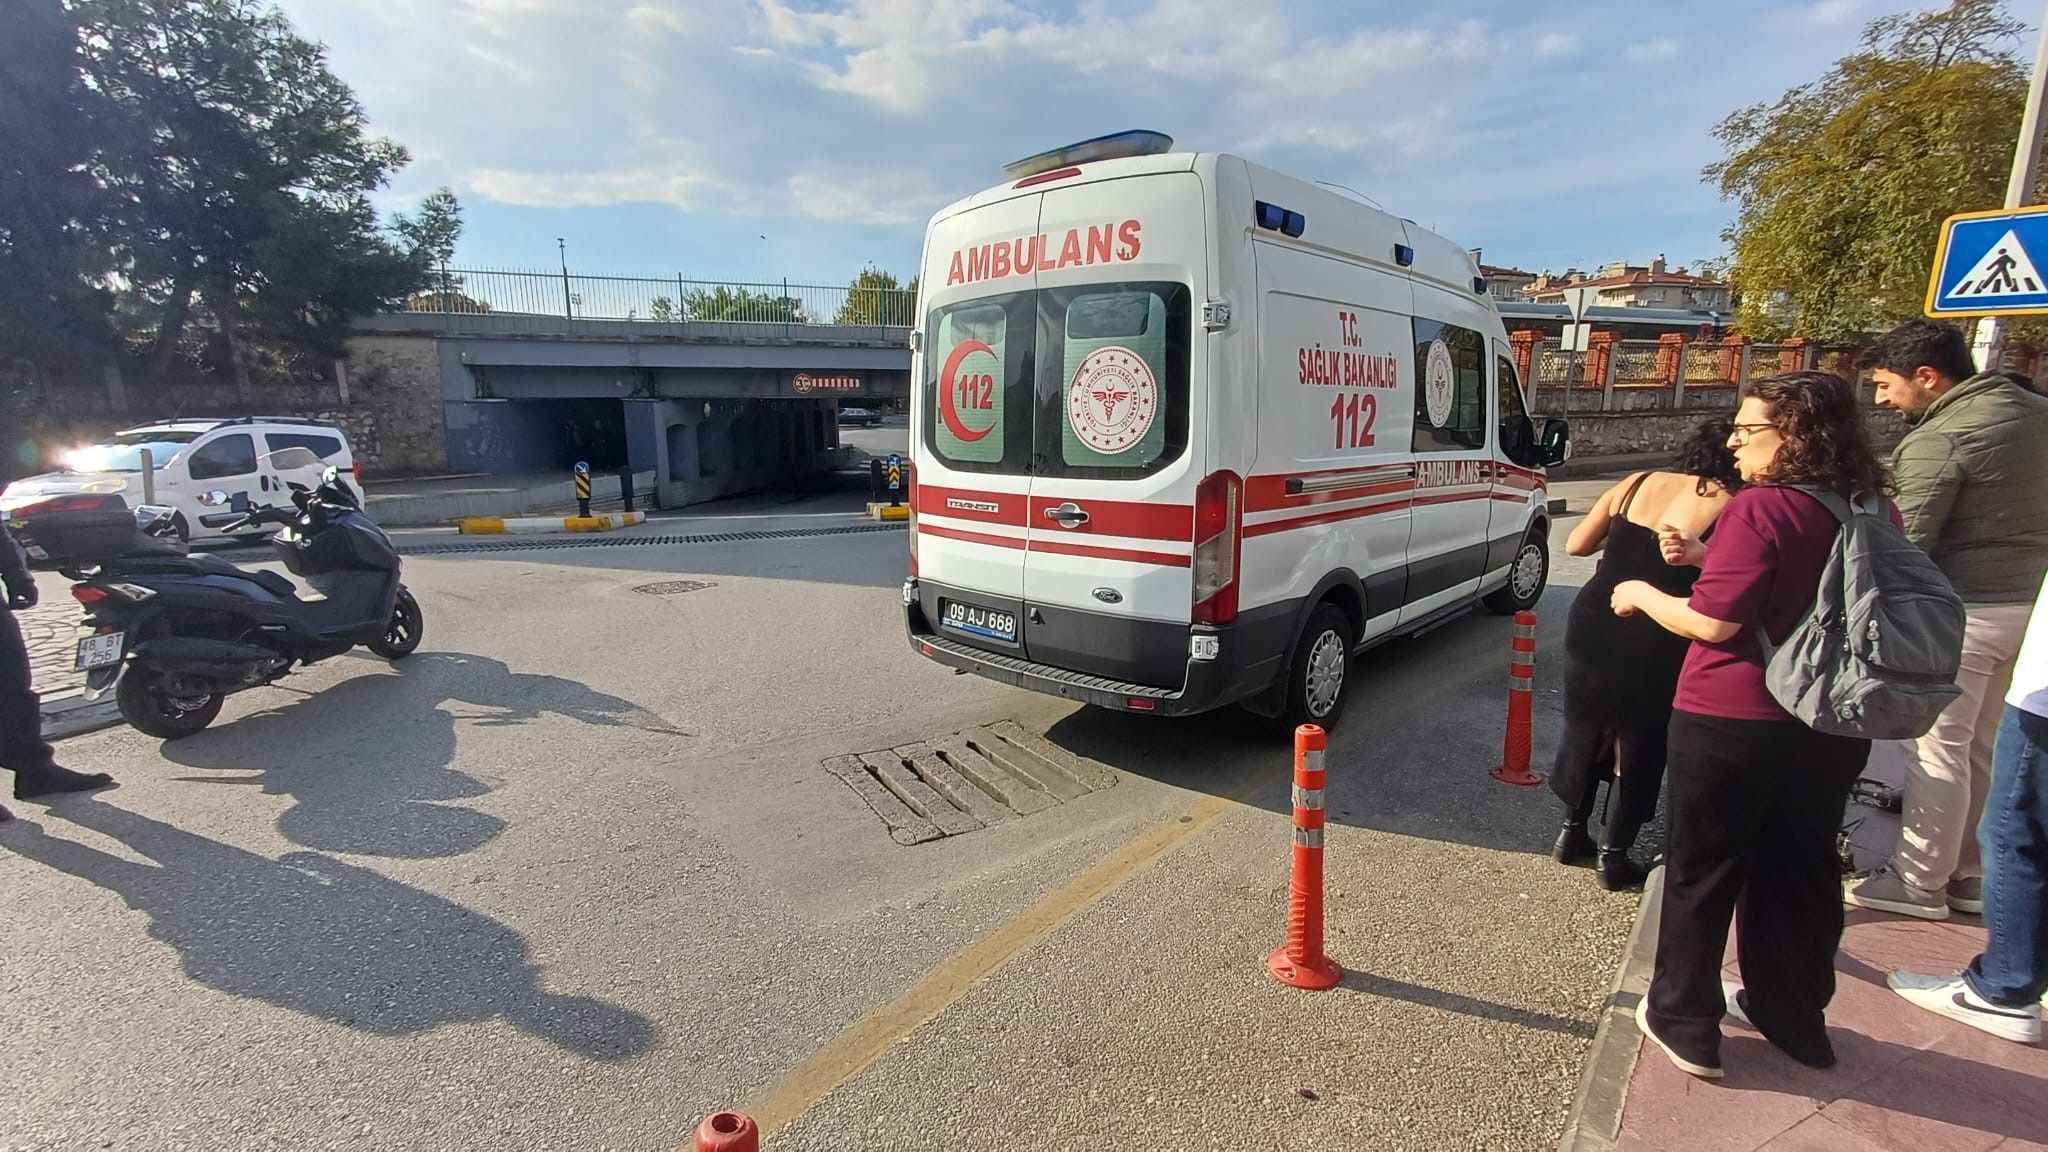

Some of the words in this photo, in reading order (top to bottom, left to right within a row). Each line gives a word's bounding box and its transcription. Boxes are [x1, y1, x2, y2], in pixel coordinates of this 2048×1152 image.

[946, 219, 1142, 286] AMBULANS
[1338, 311, 1362, 347] T.C.
[1299, 342, 1341, 386] SAĞLIK
[1344, 352, 1397, 389] BAKANLIĞI
[959, 374, 993, 409] 112
[1331, 393, 1376, 449] 112
[1417, 461, 1480, 488] AMBULANS
[950, 603, 965, 620] 09
[967, 608, 985, 626] AJ
[988, 613, 1013, 632] 668
[81, 639, 96, 651] 48
[90, 649, 112, 663] 256
